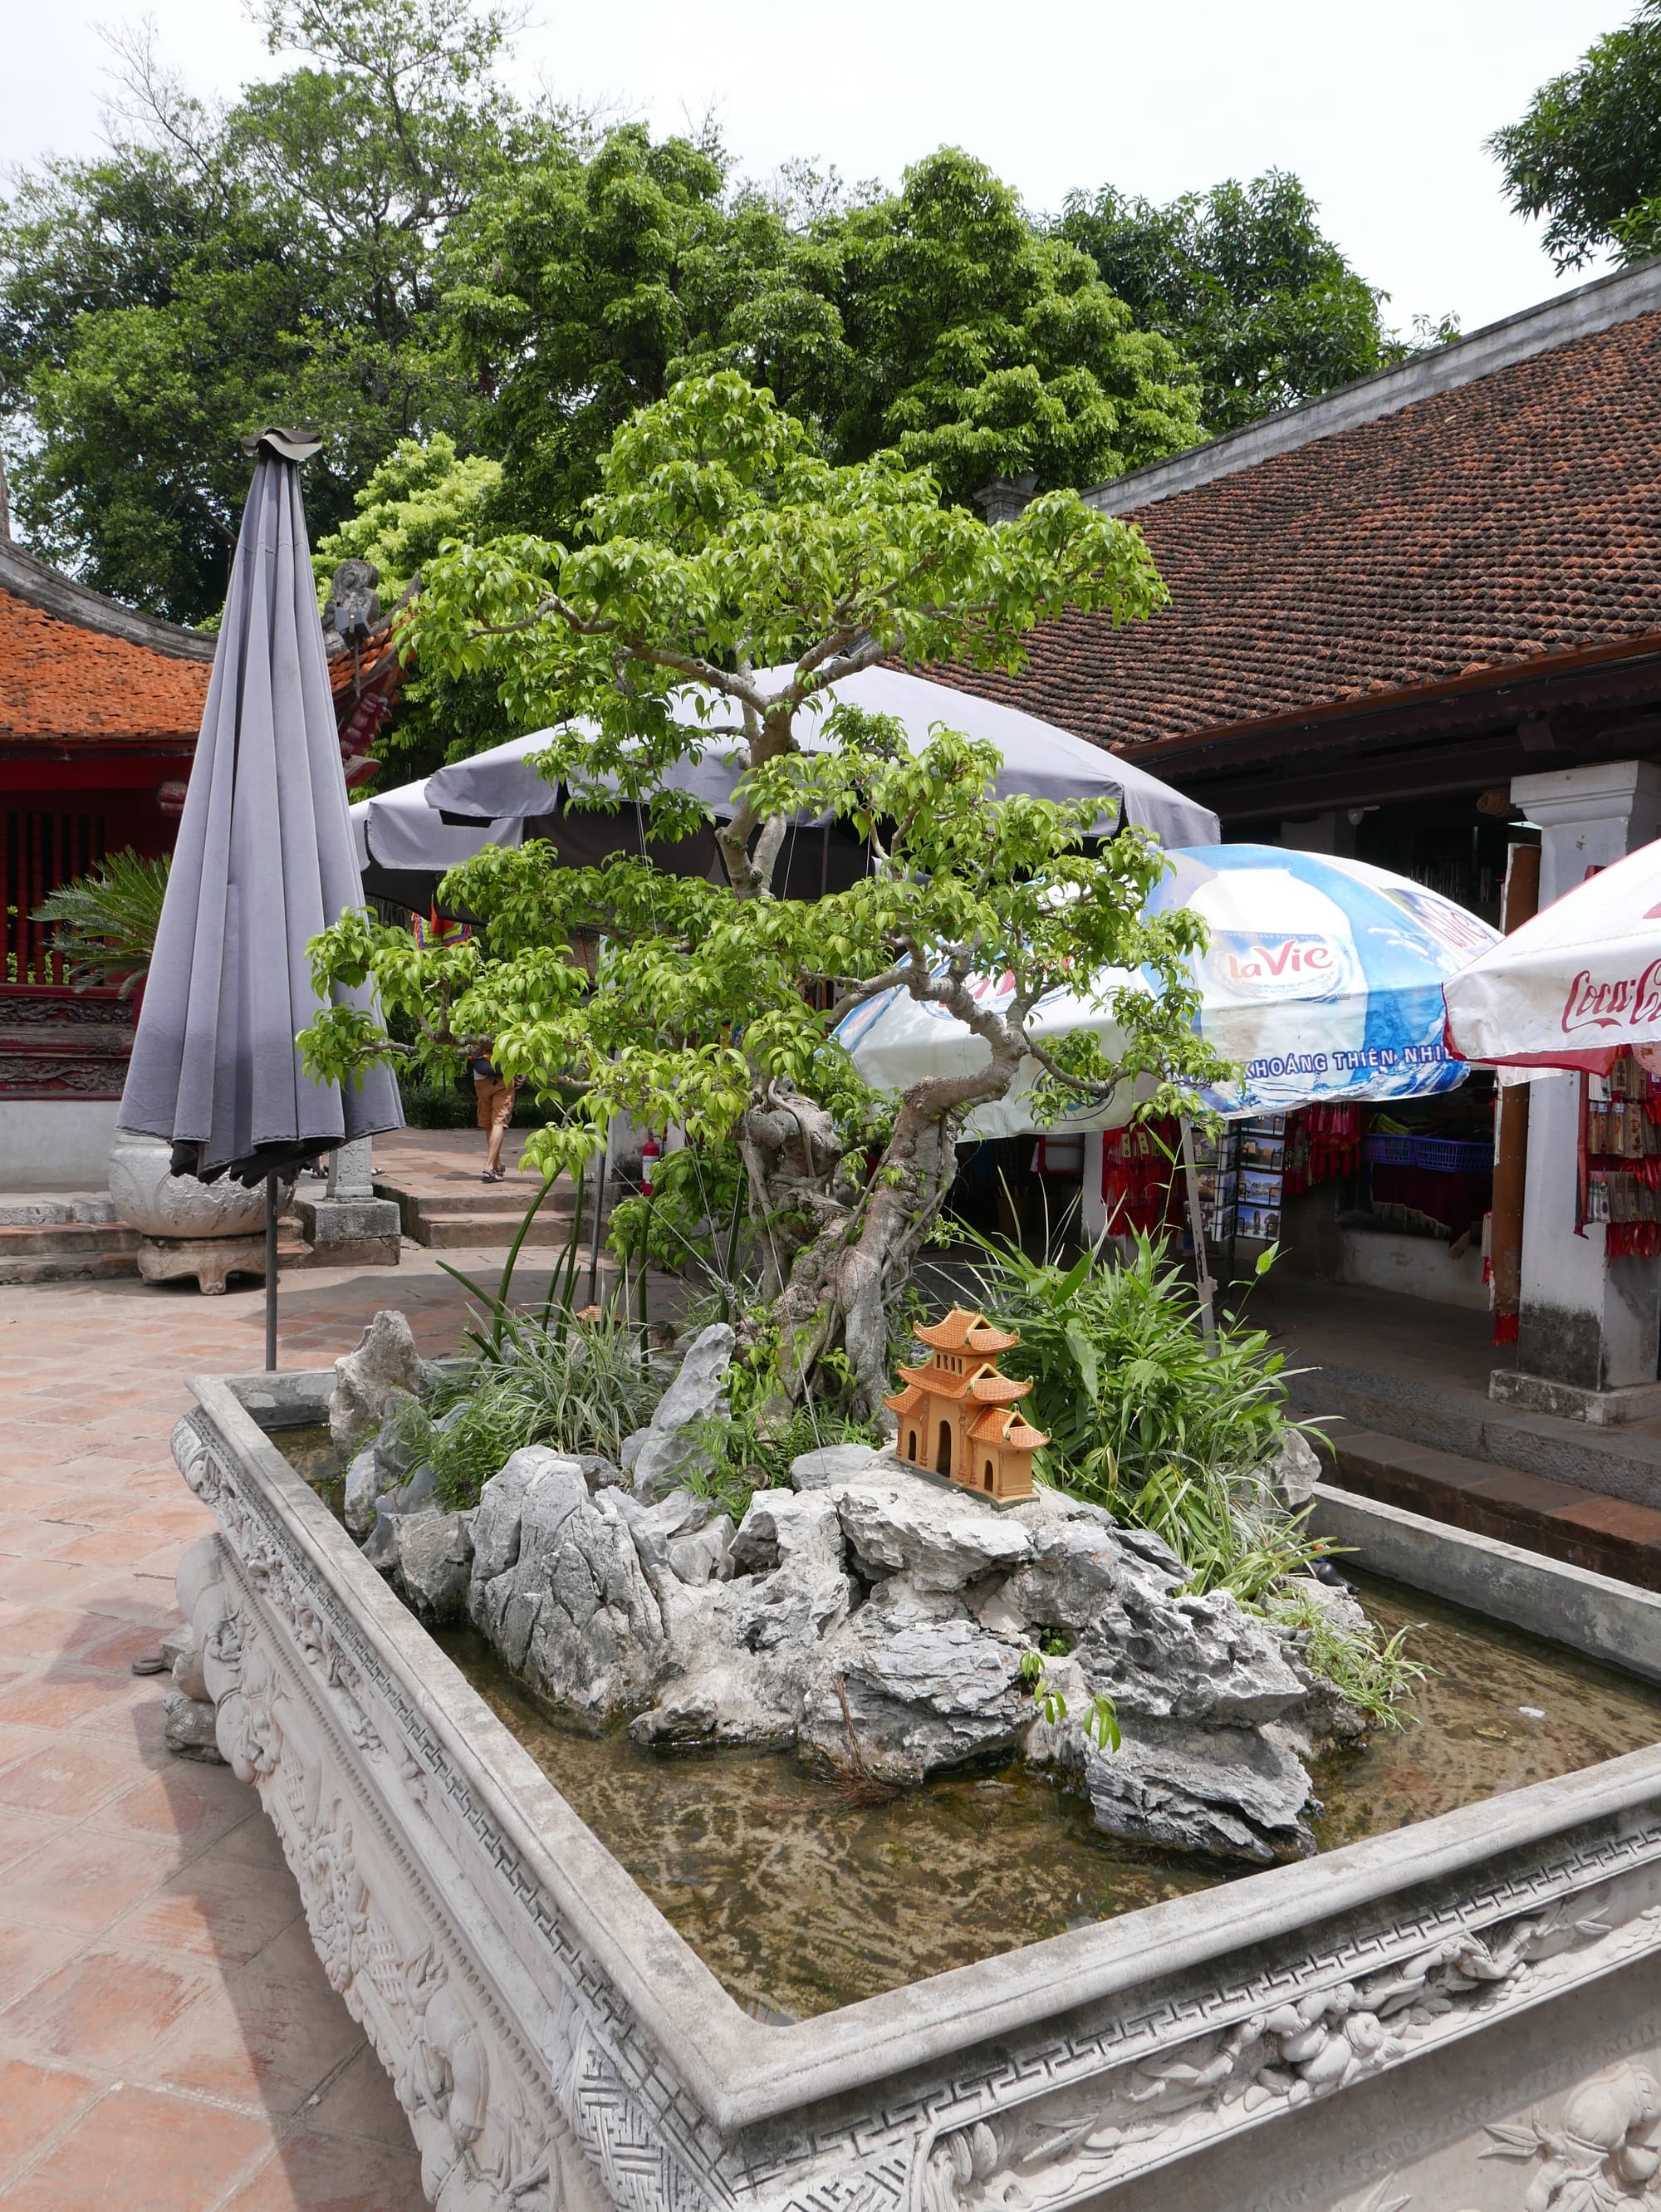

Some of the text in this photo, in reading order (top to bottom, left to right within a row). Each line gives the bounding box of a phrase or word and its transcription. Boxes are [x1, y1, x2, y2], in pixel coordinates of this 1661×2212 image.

[1227, 940, 1333, 978] laVie
[1243, 1052, 1328, 1079] KHOÁNG
[1333, 1048, 1395, 1072] THIÊN
